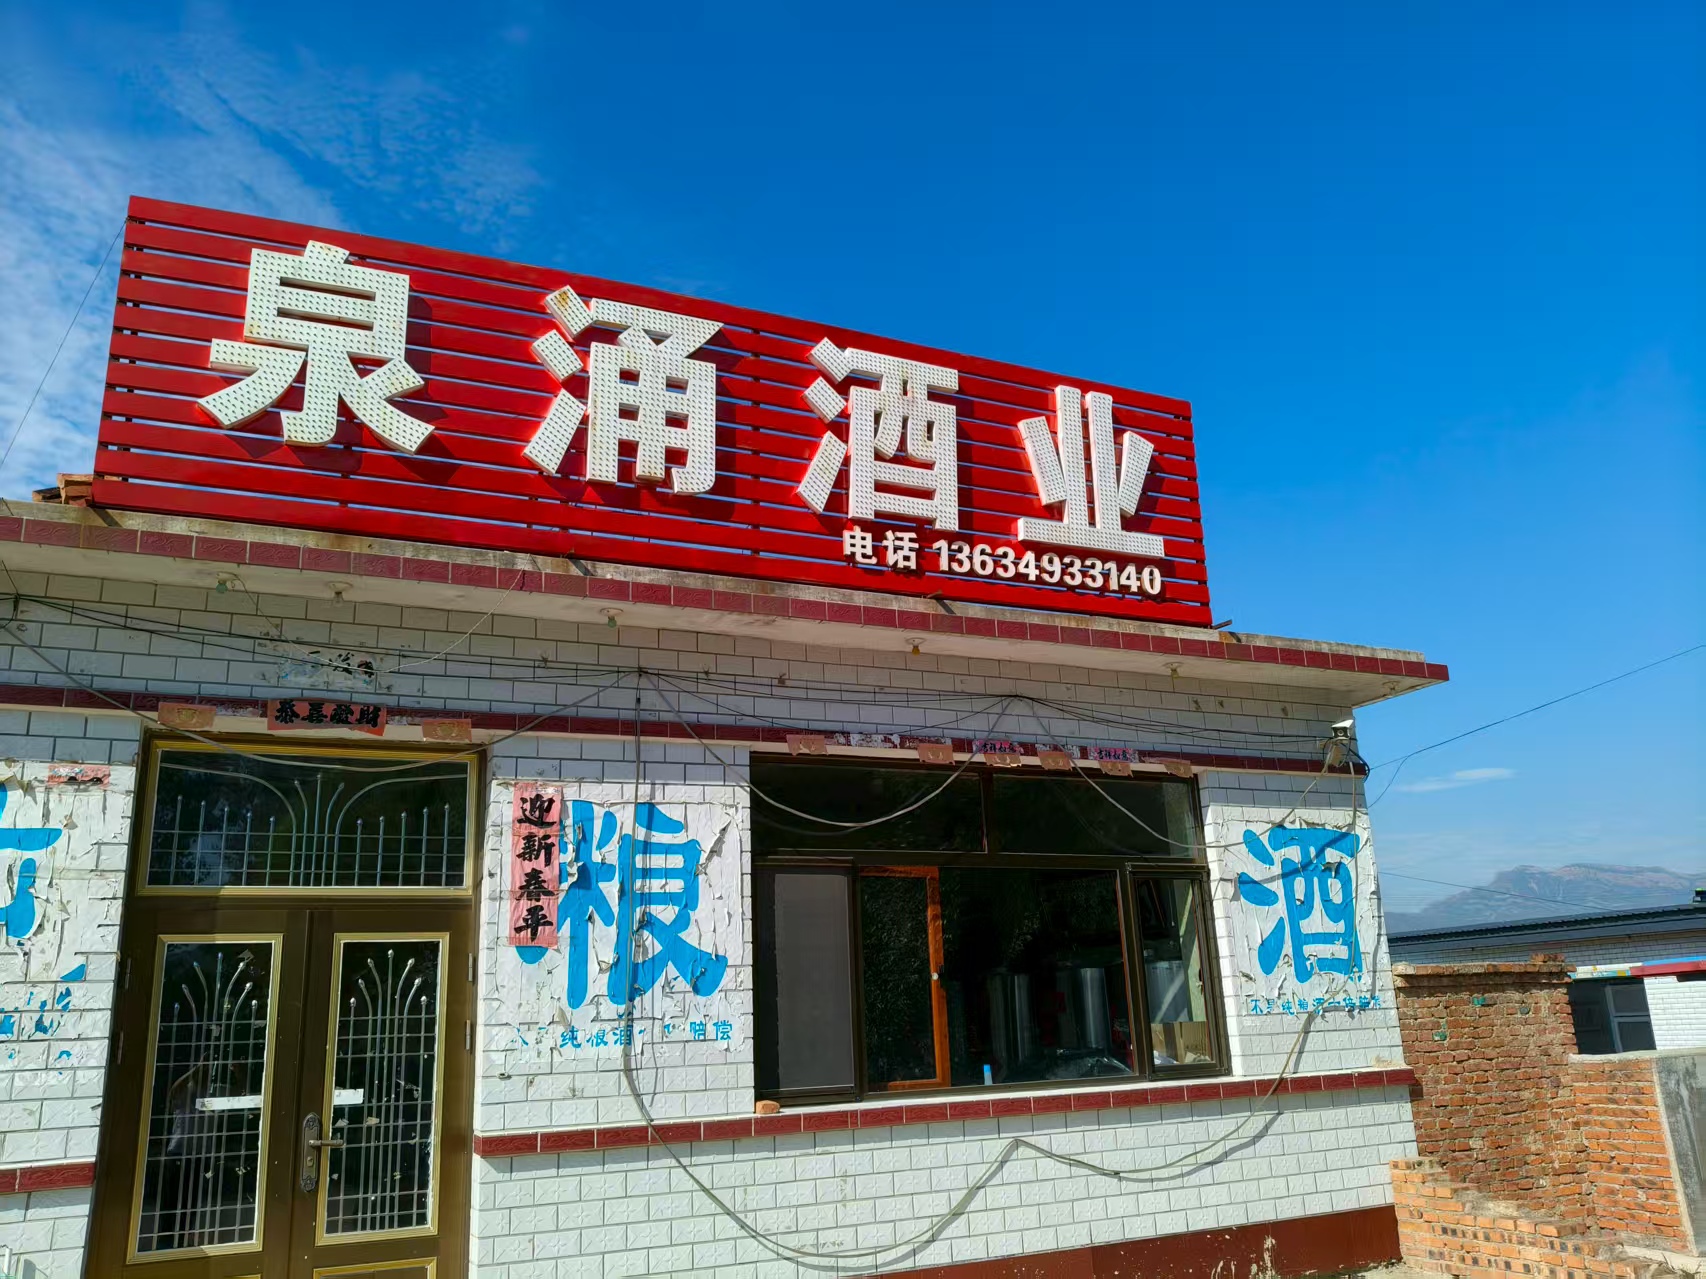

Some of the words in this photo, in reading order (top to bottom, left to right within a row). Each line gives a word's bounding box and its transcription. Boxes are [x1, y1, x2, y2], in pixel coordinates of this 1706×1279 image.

[196, 240, 1165, 558] 泉涌酒业
[842, 526, 919, 571] 电话
[932, 539, 1162, 596] 13634933140
[513, 793, 558, 943] 迎新春平
[1238, 824, 1363, 984] 酒
